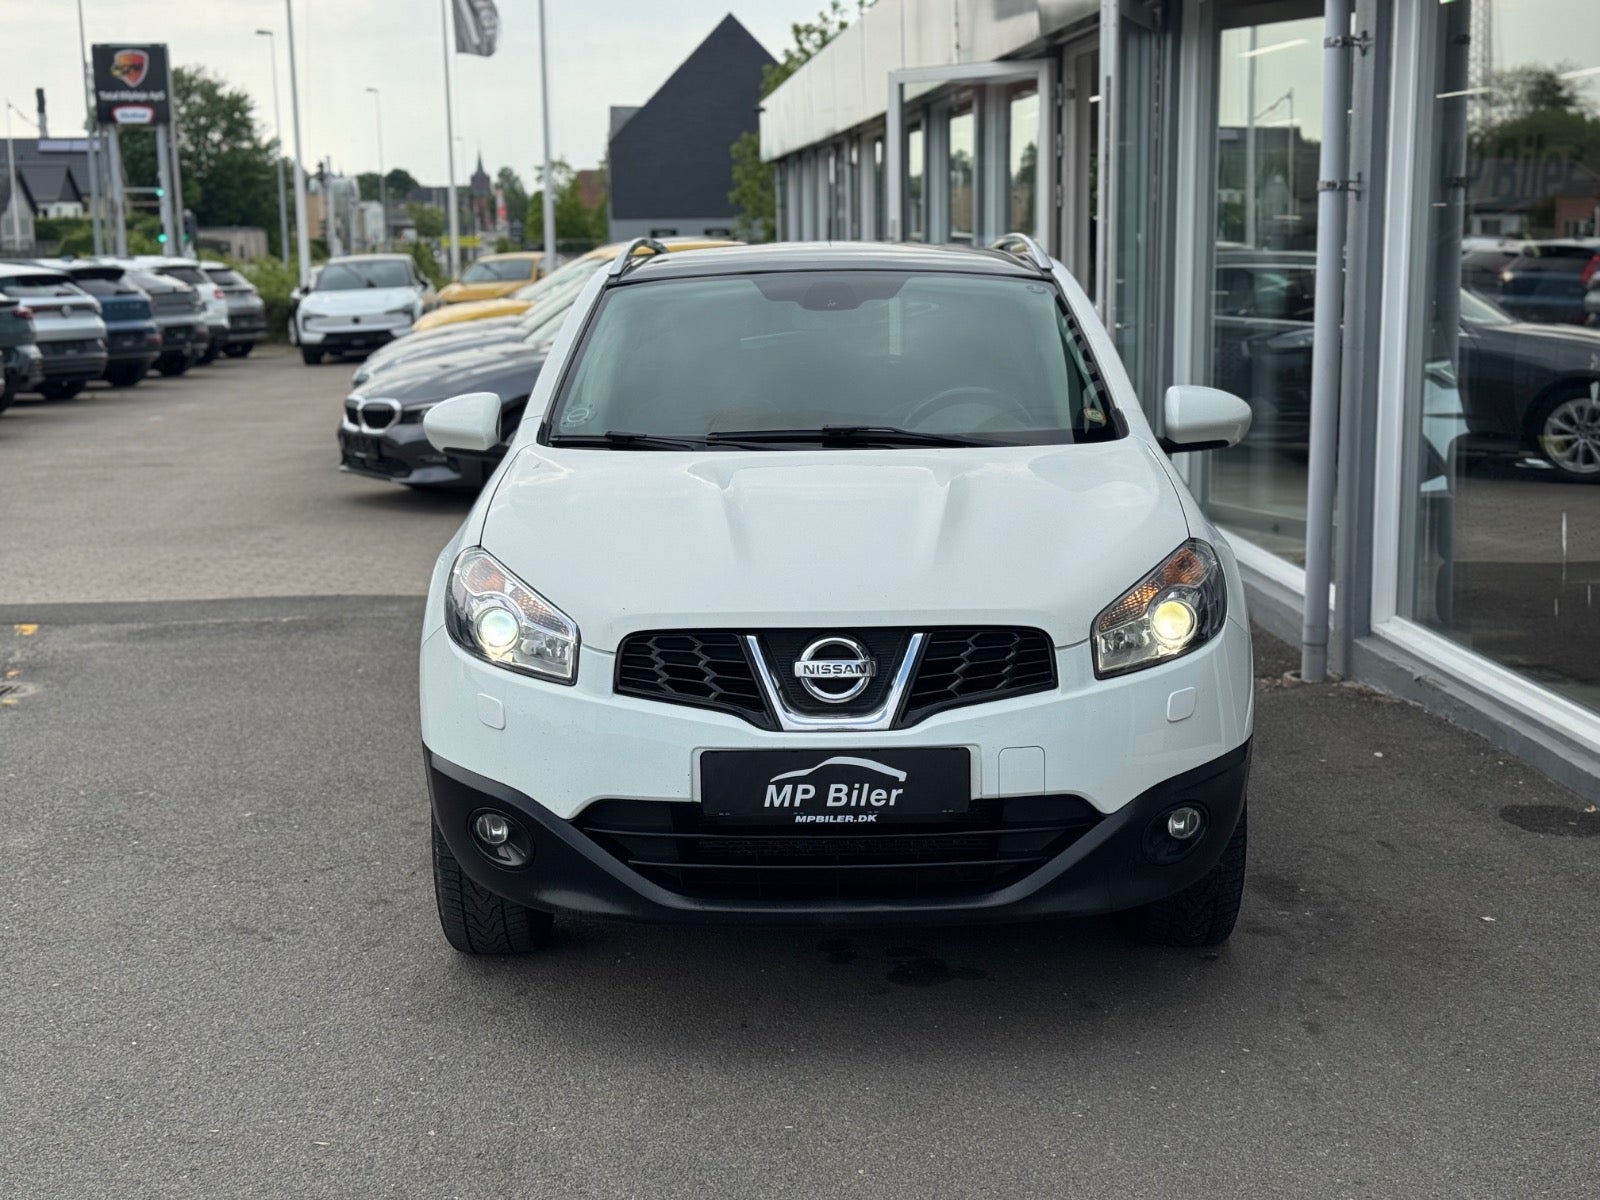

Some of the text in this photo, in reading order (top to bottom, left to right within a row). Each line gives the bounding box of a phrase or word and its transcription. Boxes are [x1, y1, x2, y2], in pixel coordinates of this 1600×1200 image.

[803, 664, 867, 675] NISSAN
[764, 783, 903, 808] MP Biler
[795, 814, 878, 824] MPBILER.DK
